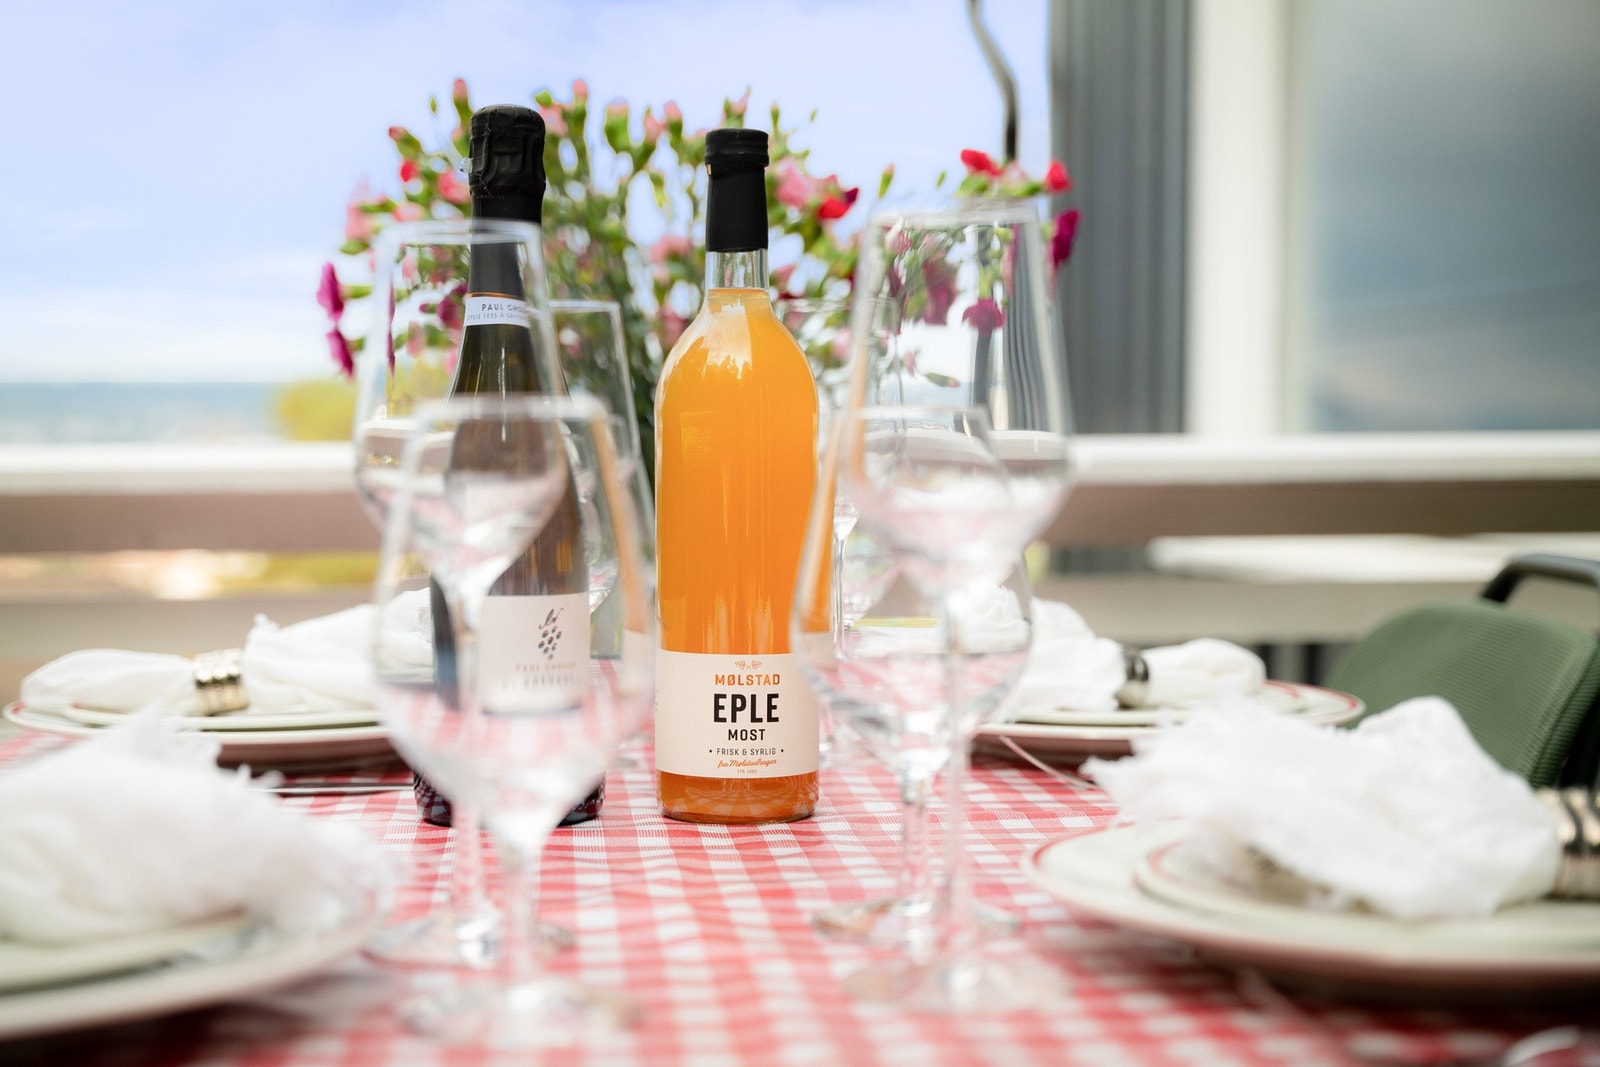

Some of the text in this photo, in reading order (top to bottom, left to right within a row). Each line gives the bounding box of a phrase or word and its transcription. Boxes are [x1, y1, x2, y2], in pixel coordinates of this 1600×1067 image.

[481, 303, 504, 312] PAUL
[714, 673, 781, 686] MØLSTAD
[713, 693, 780, 723] EPLE
[728, 728, 766, 741] MOST
[716, 747, 777, 756] FRISK & SYRLIG
[717, 759, 729, 769] fra
